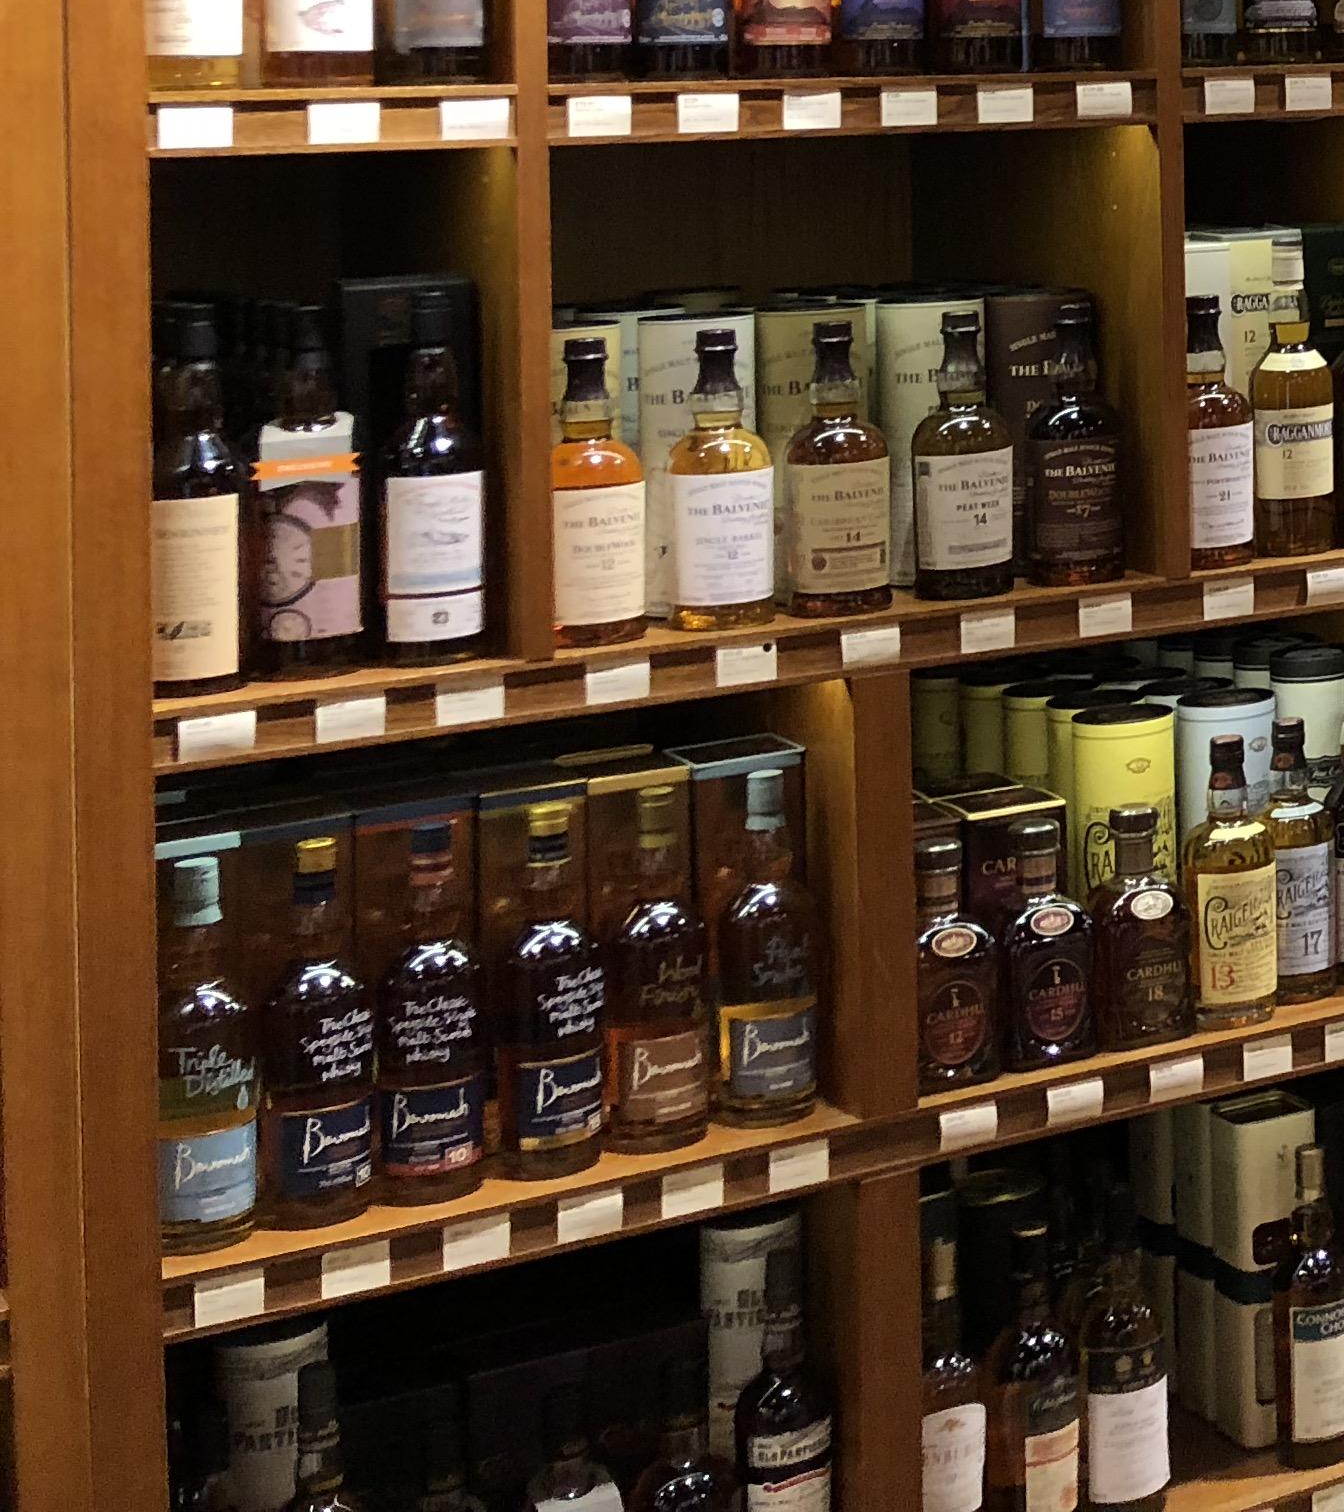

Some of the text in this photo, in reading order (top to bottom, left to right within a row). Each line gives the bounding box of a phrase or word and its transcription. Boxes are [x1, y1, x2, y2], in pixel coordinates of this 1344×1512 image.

[1244, 329, 1256, 344] 12
[973, 512, 988, 527] 14
[1302, 929, 1323, 957] 17
[1210, 964, 1236, 991] 13
[1147, 984, 1165, 1002] 18
[449, 1144, 470, 1164] 10
